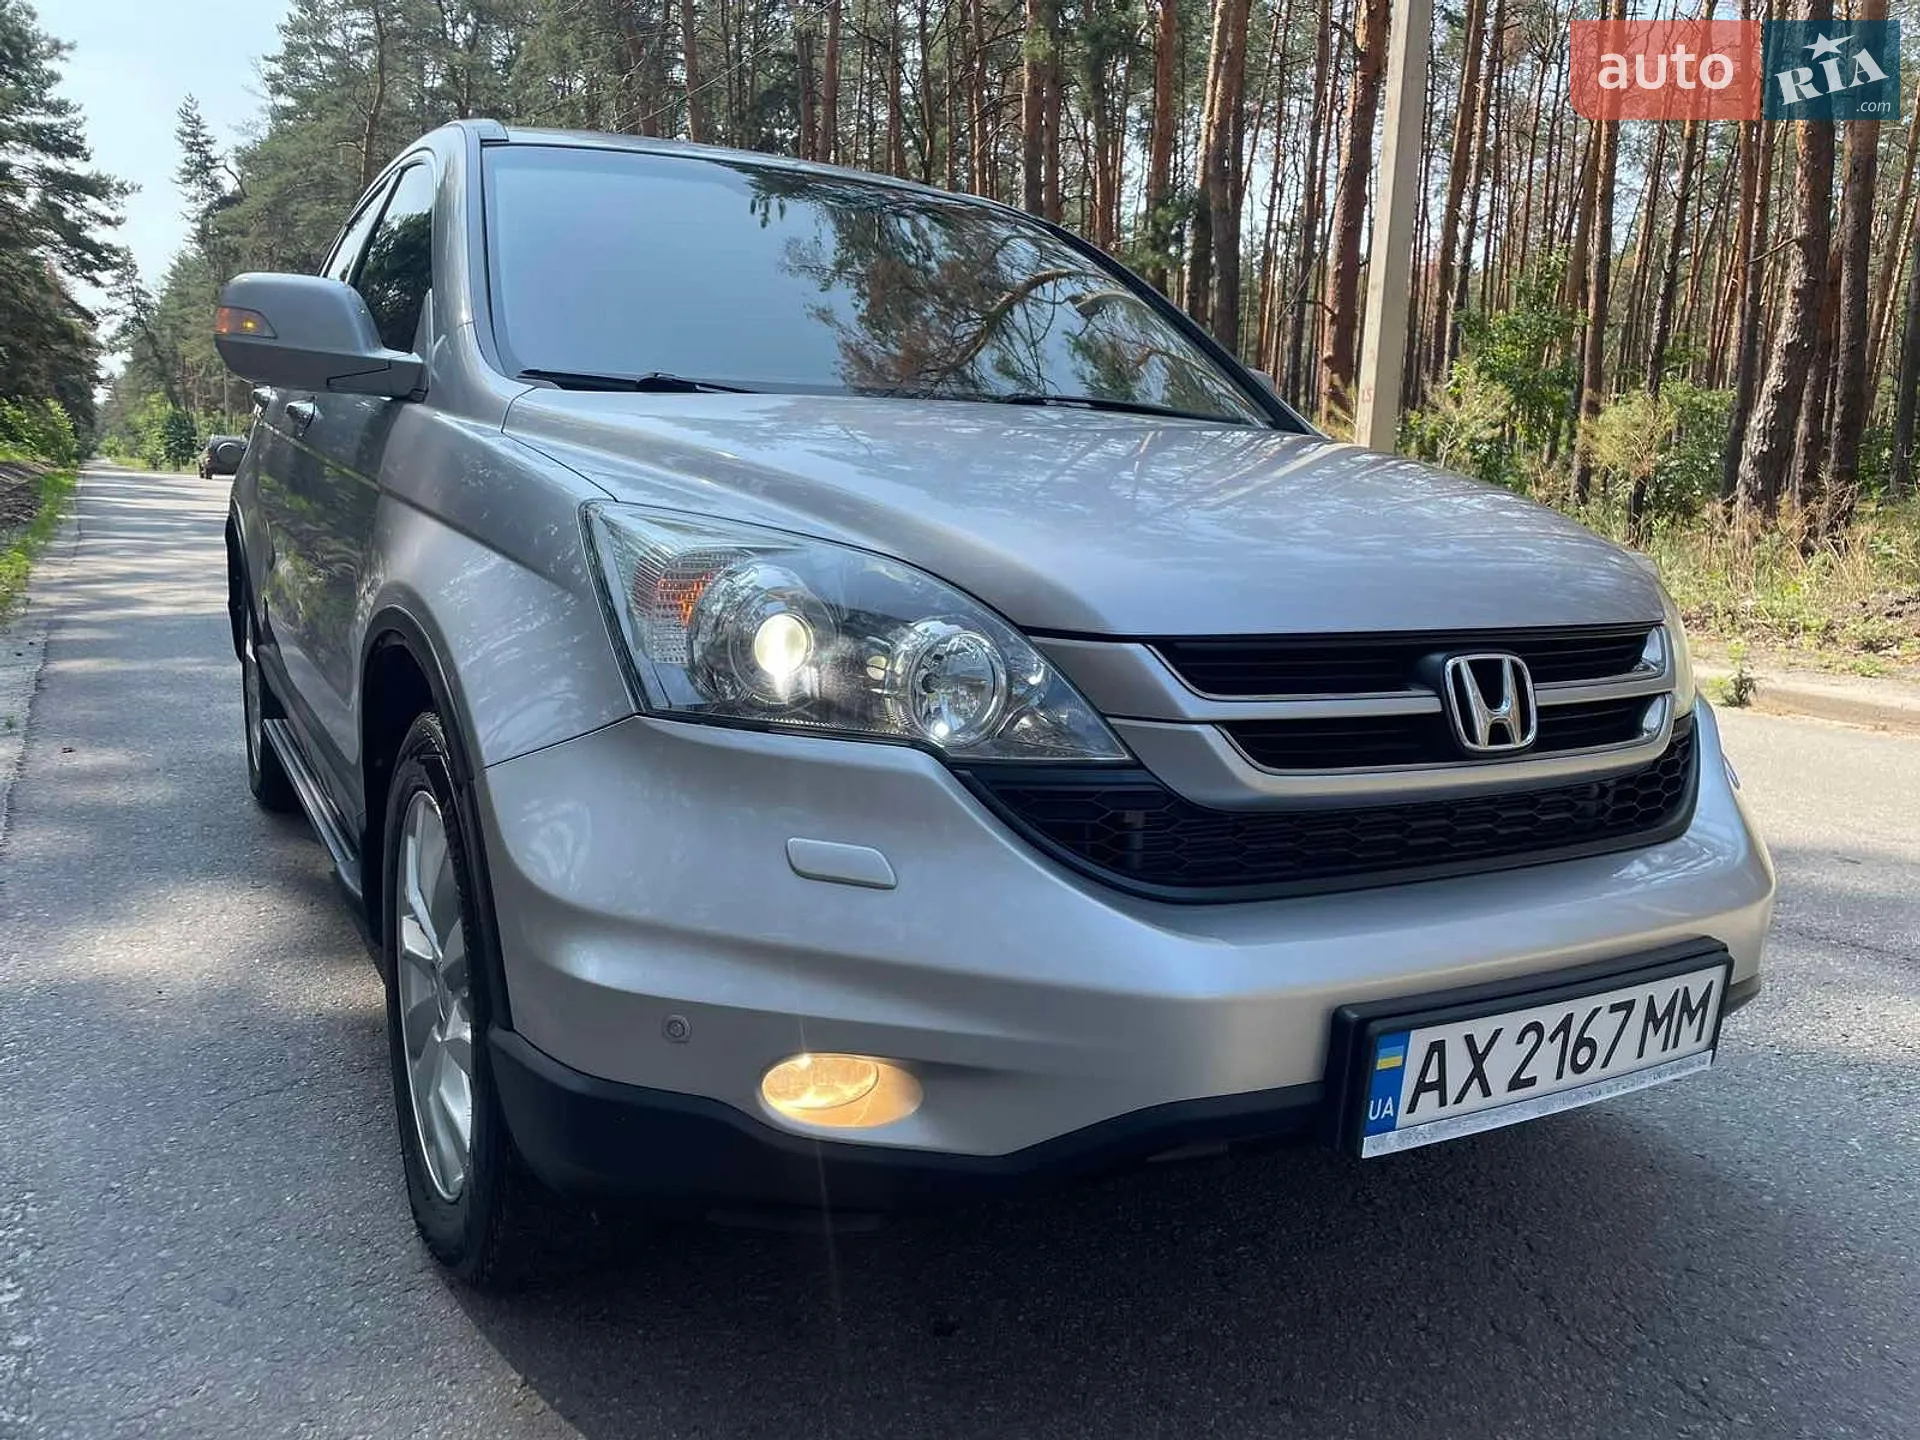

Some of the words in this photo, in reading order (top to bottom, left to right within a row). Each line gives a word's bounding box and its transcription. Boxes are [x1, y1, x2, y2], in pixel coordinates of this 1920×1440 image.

[1406, 1027, 1504, 1115] AX
[1508, 998, 1636, 1092] 2167
[1636, 979, 1714, 1060] MM
[1368, 1096, 1394, 1121] UA
